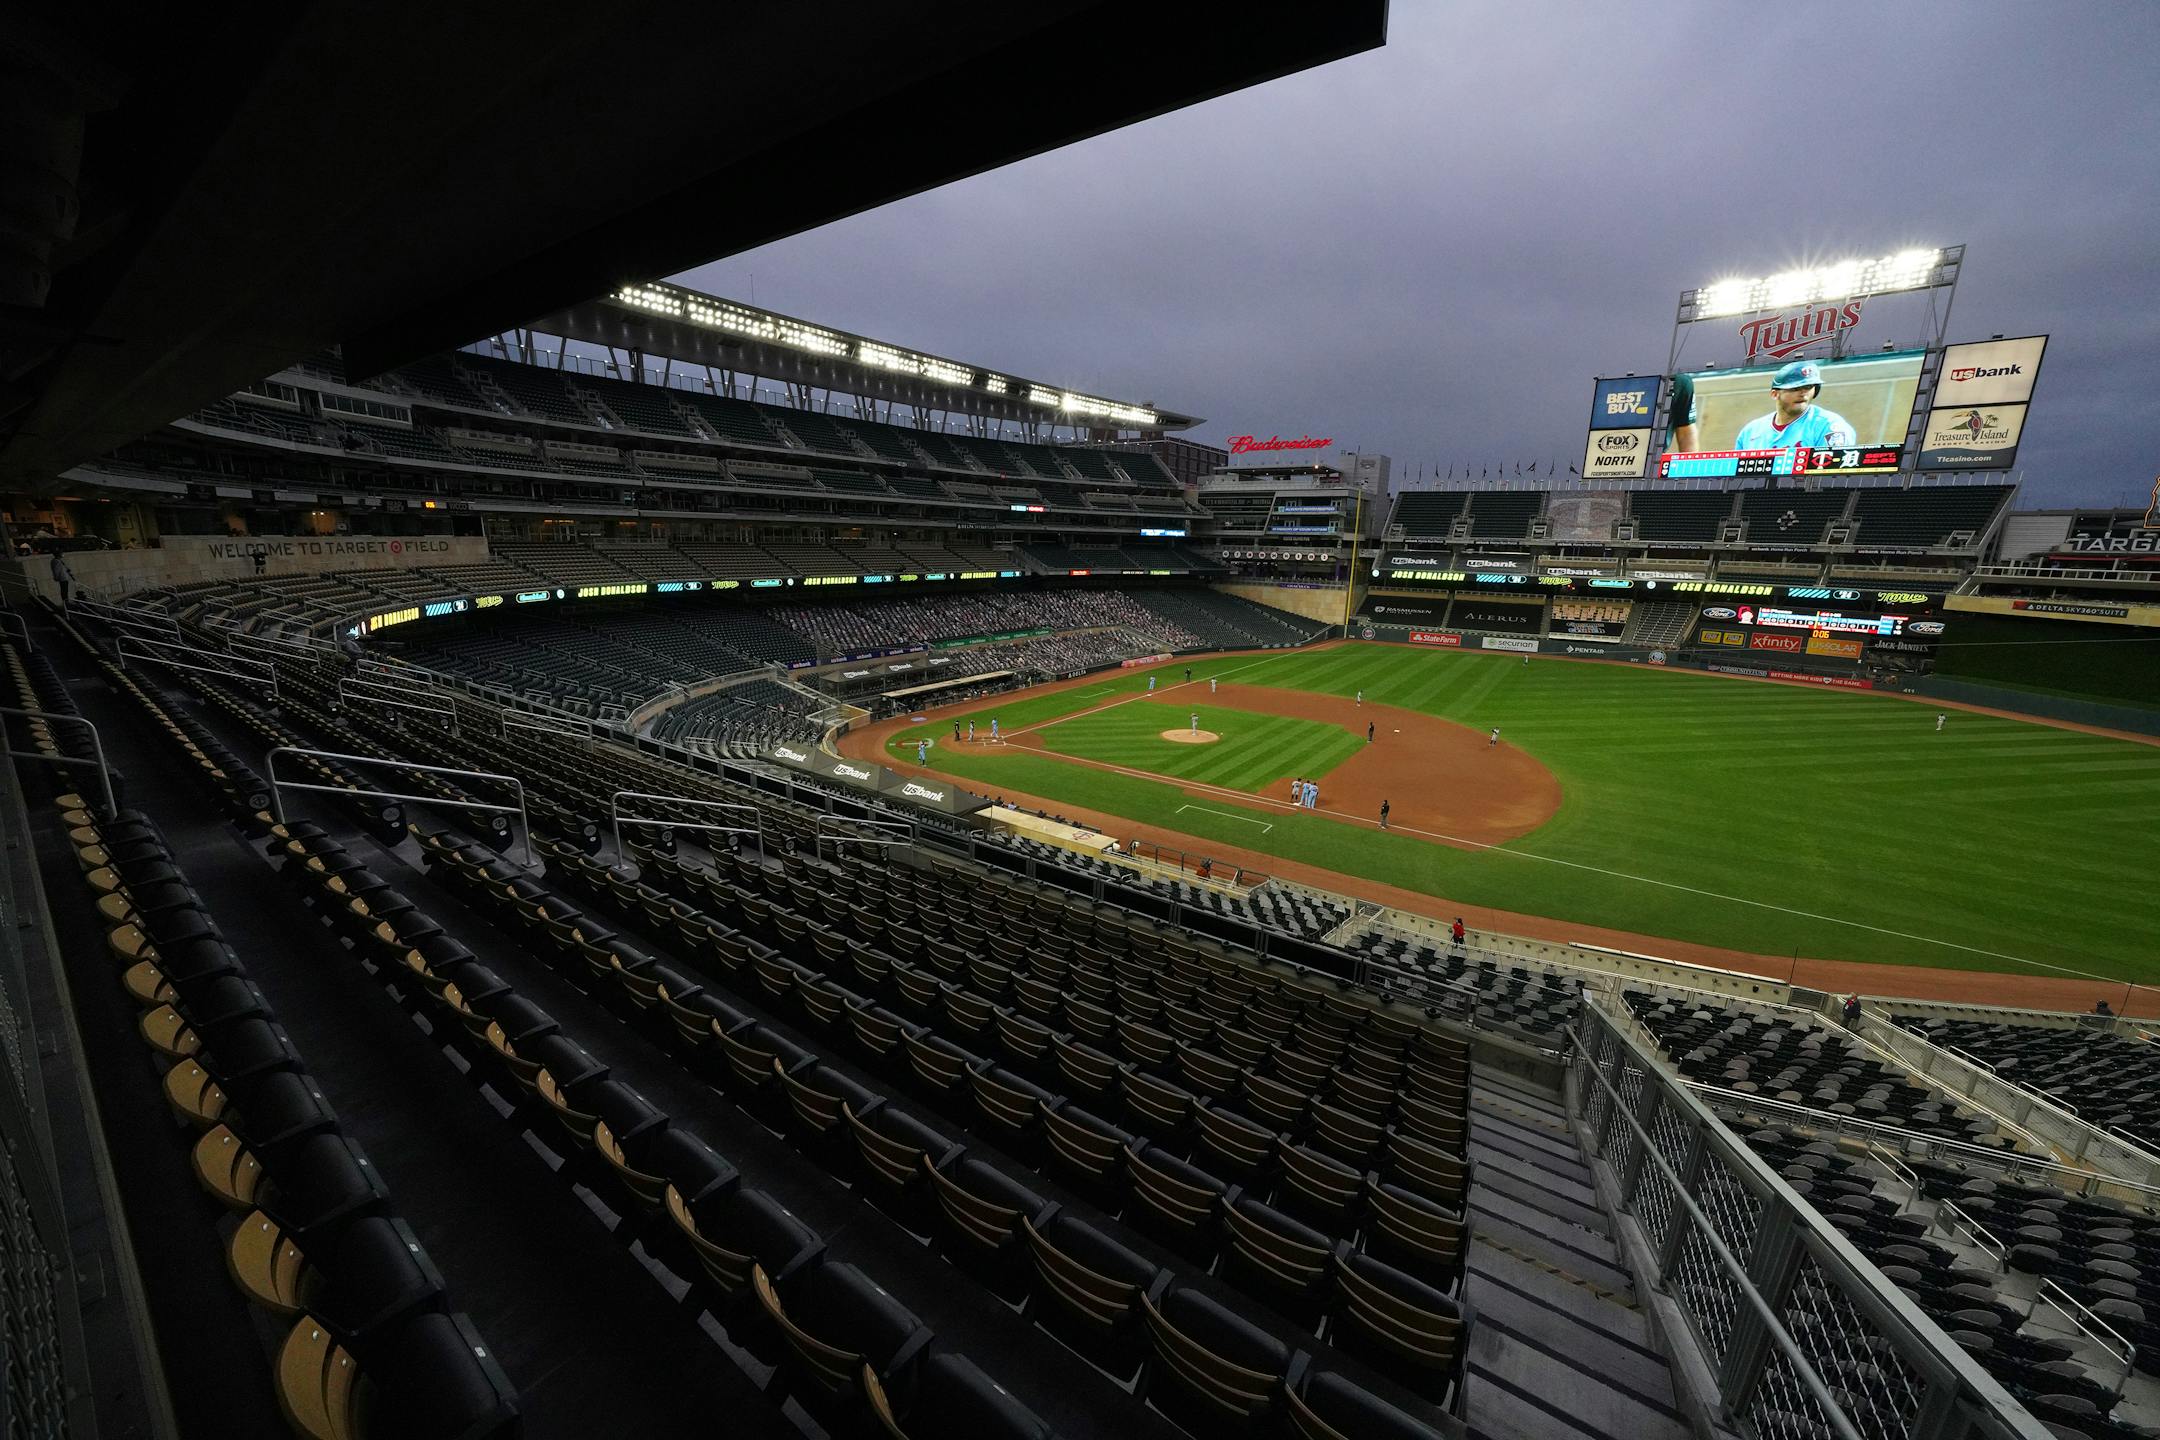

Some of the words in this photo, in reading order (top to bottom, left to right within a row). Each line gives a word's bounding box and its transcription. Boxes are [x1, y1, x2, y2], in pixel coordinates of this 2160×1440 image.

[1739, 300, 1862, 359] Twins
[1607, 392, 1645, 404] BEST
[1608, 403, 1639, 414] BUY
[1606, 435, 1630, 446] FOX
[1934, 431, 1971, 442] Treasure
[1980, 429, 2009, 440] Island
[1228, 434, 1334, 454] Budweiser
[1595, 456, 1635, 466] NORTH
[208, 543, 295, 558] WELCOME
[297, 542, 322, 555] TO
[325, 541, 387, 554] TARGET
[405, 541, 449, 552] FIELD
[1391, 571, 1414, 579] JOSH
[1415, 572, 1466, 581] DONALDSON
[577, 587, 599, 598] JOSH
[600, 584, 647, 596] DONALDSON
[1672, 583, 1703, 592] JOSH
[1704, 583, 1773, 595] DONALDSON
[2036, 604, 2063, 612] DELTA
[1465, 613, 1527, 623] ALERUS
[1498, 639, 1533, 649] securian
[1754, 635, 1799, 650] xfinity
[1875, 640, 1895, 649] JACK
